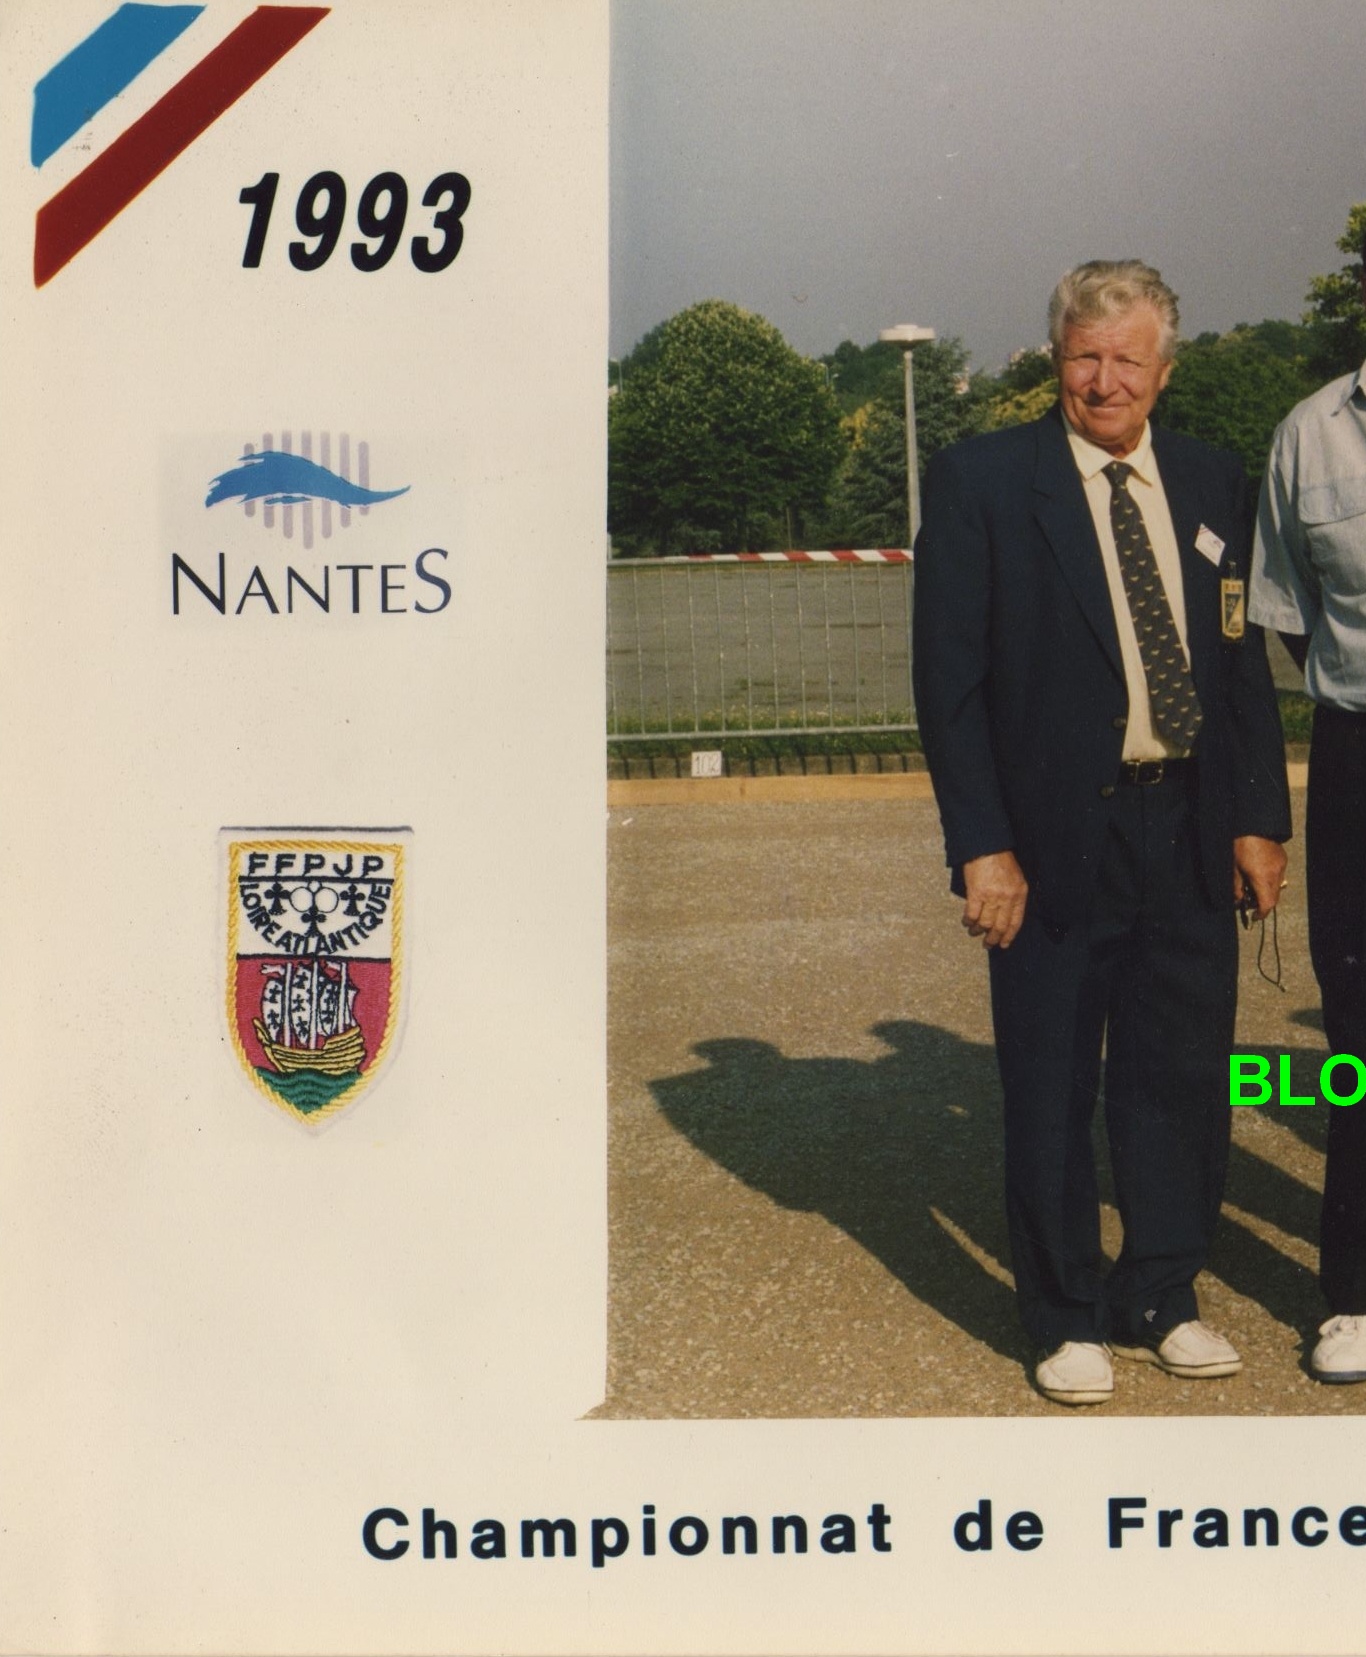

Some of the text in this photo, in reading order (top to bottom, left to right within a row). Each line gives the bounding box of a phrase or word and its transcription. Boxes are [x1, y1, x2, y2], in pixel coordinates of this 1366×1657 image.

[239, 171, 471, 273] 1993
[247, 852, 385, 877] FFPJP
[362, 1503, 892, 1568] Championnat
[953, 1499, 1044, 1552] de
